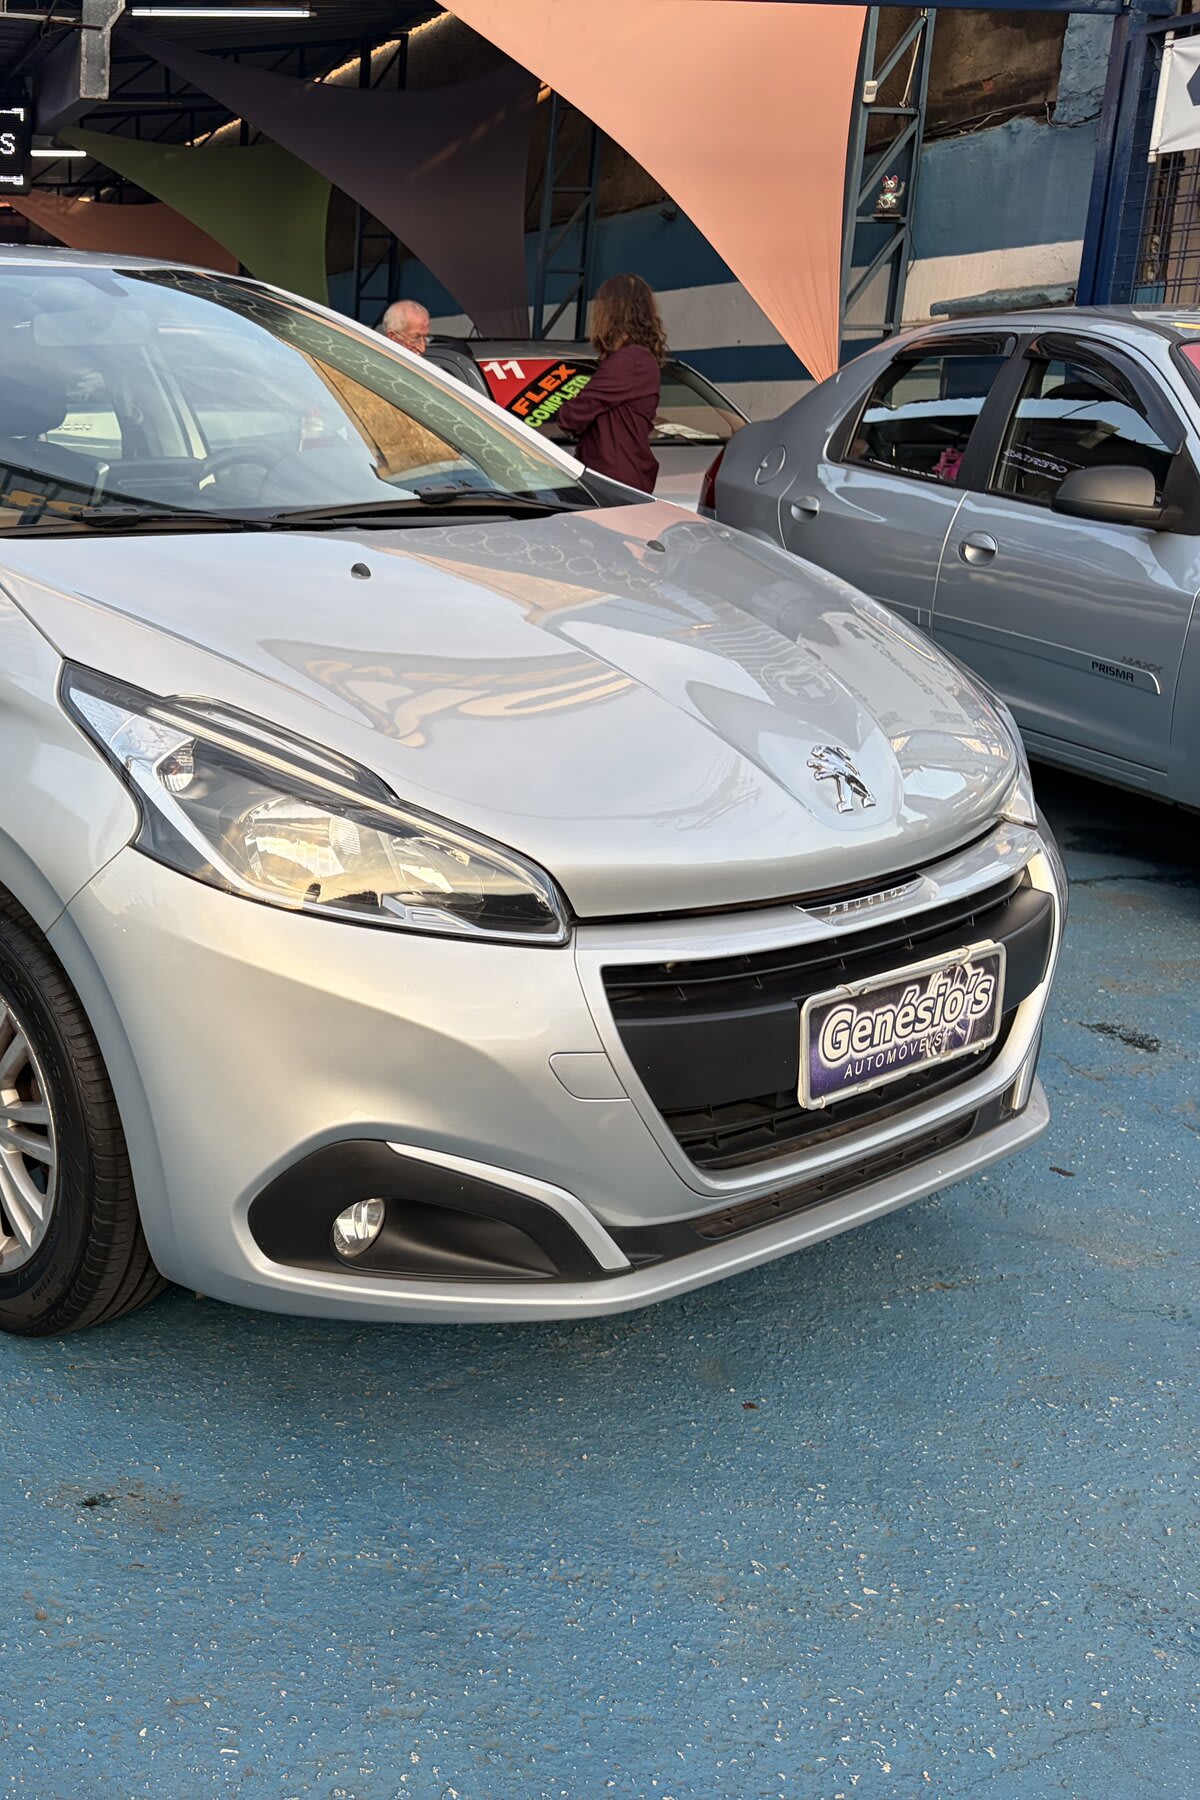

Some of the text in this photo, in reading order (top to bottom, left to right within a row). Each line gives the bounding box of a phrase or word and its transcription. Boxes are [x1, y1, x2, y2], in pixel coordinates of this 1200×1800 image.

[483, 360, 526, 380] 11
[511, 363, 577, 416] FLEX
[1091, 661, 1135, 683] PRISMA
[828, 886, 907, 915] PEUGEOT
[820, 970, 994, 1066] Genésio's
[843, 1032, 943, 1080] AUTOMÓVEIS
